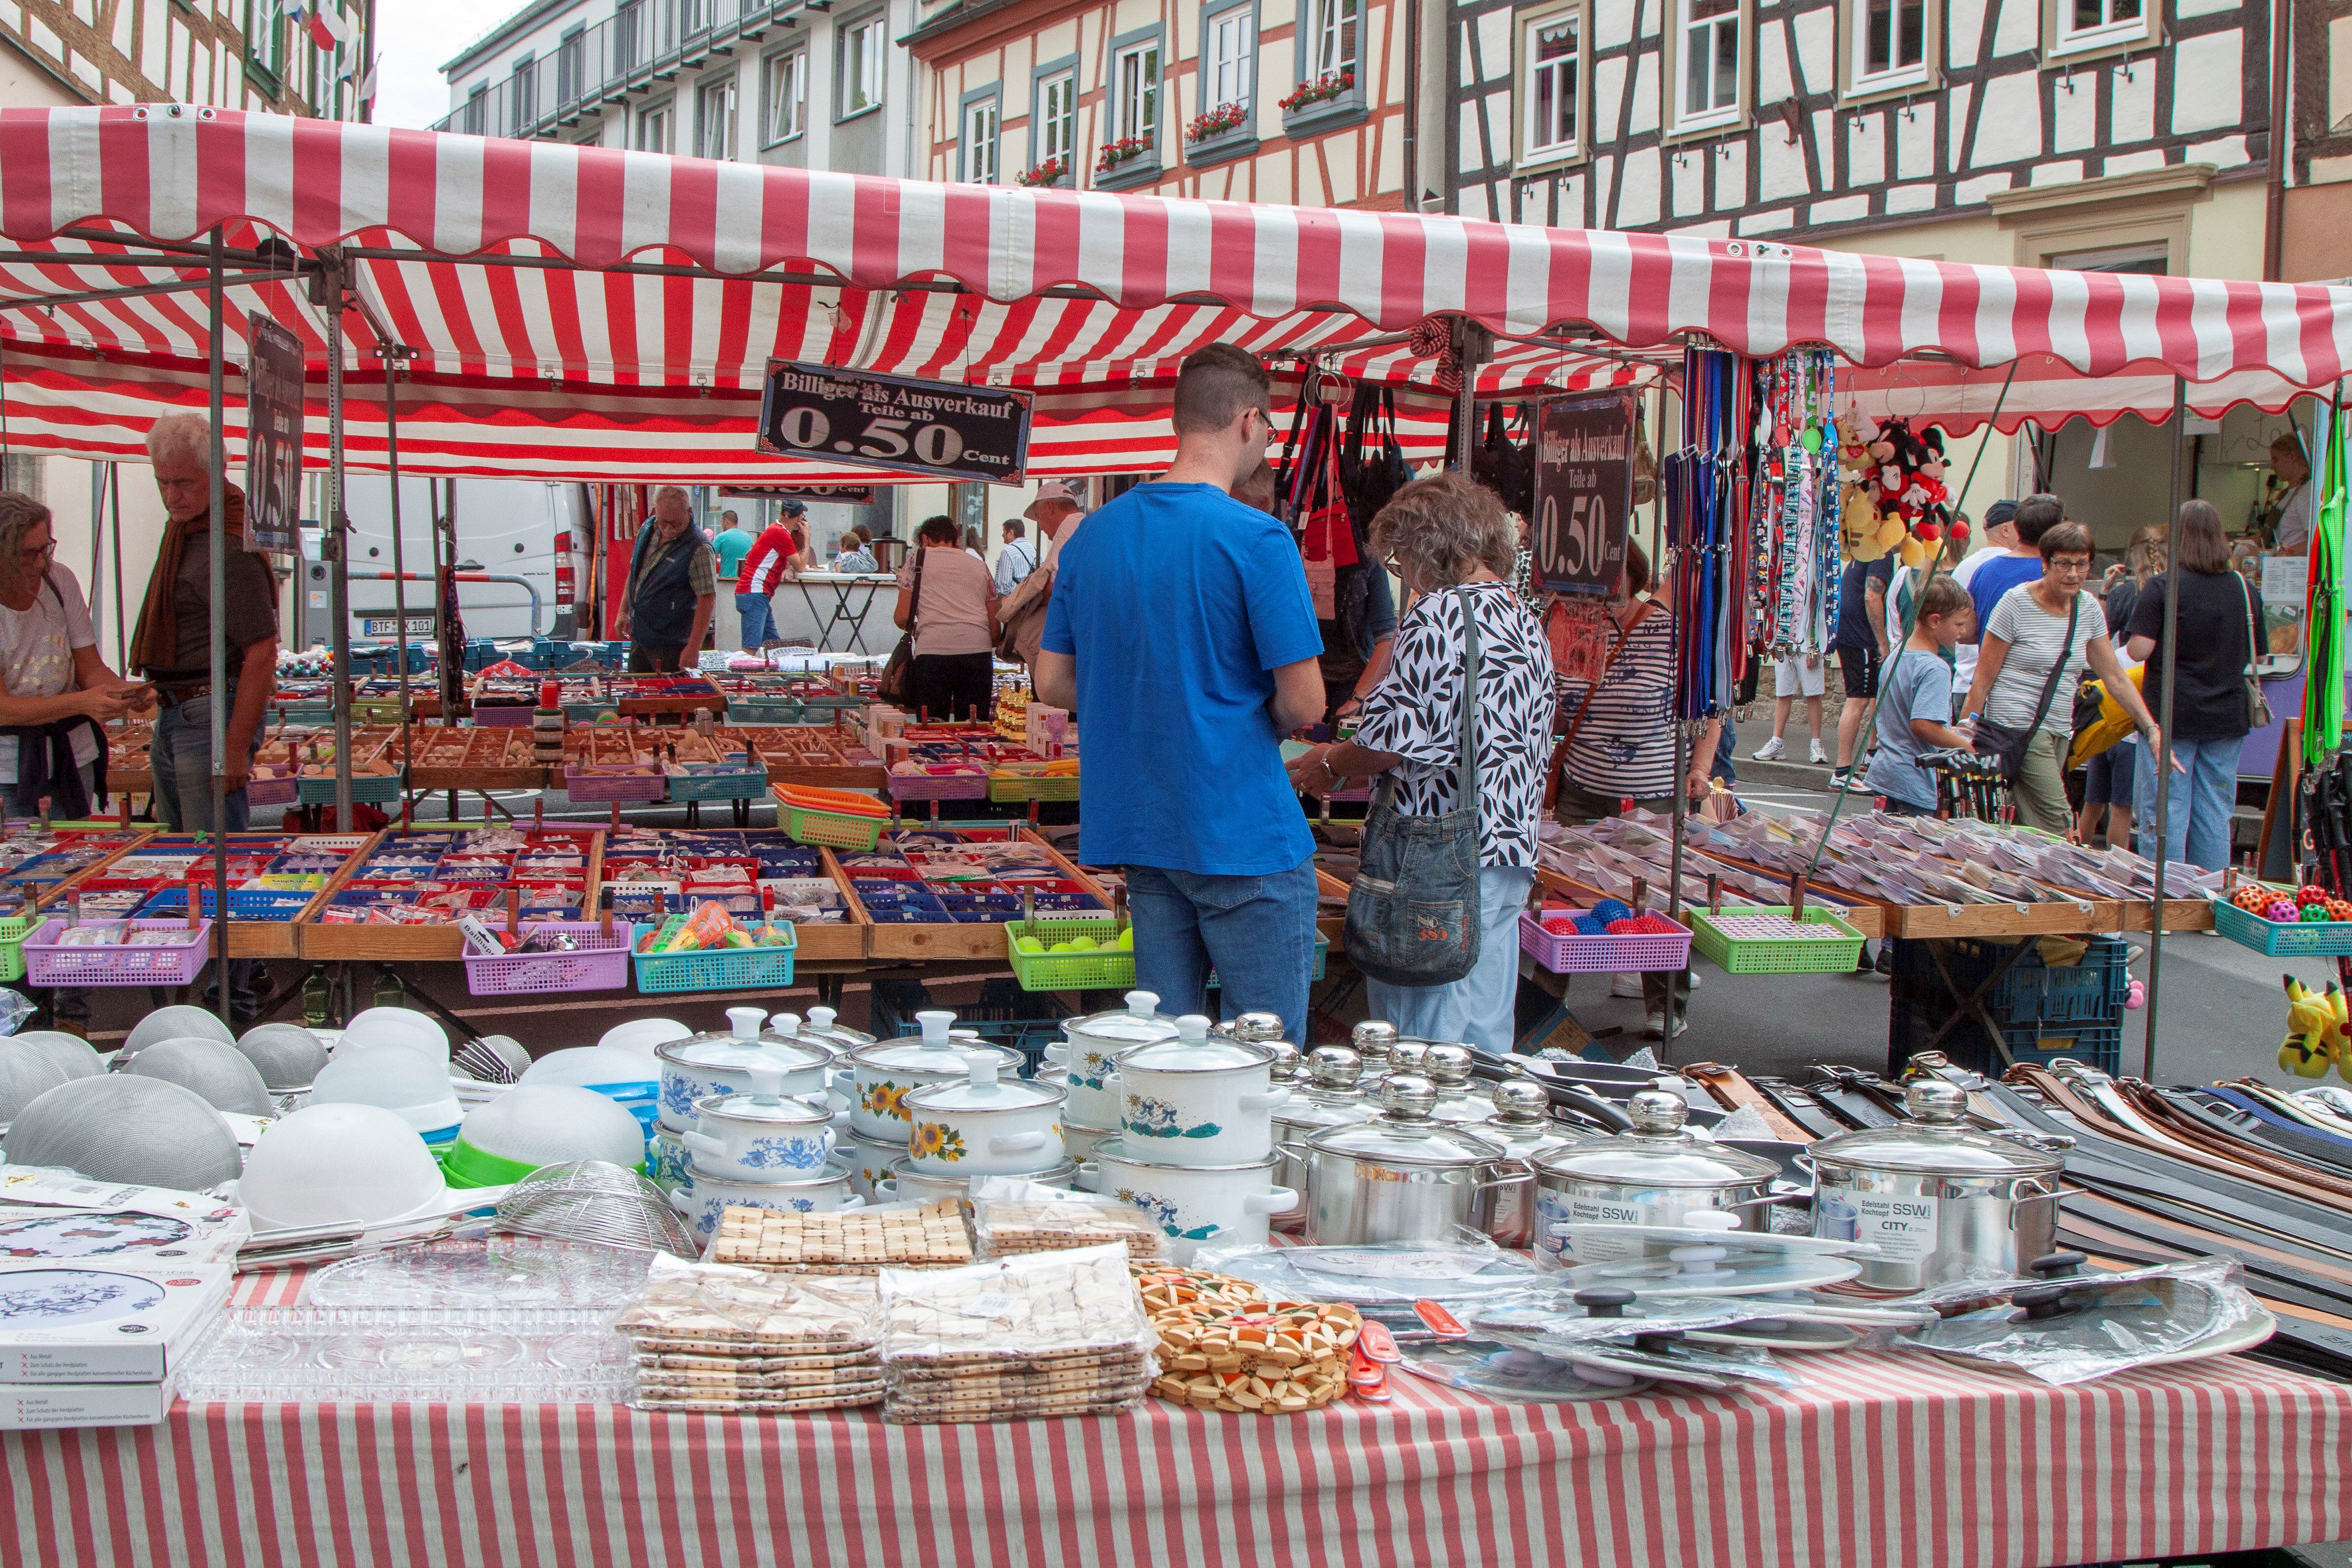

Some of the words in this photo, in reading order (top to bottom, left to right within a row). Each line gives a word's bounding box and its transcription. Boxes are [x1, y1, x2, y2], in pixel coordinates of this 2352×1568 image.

[781, 372, 856, 400] Billiger
[862, 384, 889, 402] als
[895, 389, 1014, 419] Ausverkauf
[858, 402, 904, 418] Teile
[911, 410, 935, 421] ab
[781, 406, 963, 465] 0.50
[1542, 431, 1569, 472] Billiger
[1570, 428, 1581, 462] als
[1581, 424, 1626, 463] Ausverkauf
[963, 450, 1010, 465] Cent
[253, 432, 292, 526] 0.50
[1569, 469, 1586, 489] Teile
[1587, 469, 1596, 488] ab
[1540, 494, 1606, 576] 0.50
[1606, 540, 1620, 560] Cent
[372, 621, 390, 632] BTF
[412, 621, 430, 631] 101
[1574, 1202, 1599, 1212] Edelstahl
[1862, 1201, 1889, 1209] Edelstahl
[1893, 1203, 1927, 1216] SSW
[1573, 1210, 1598, 1221] Kochtopf
[1602, 1207, 1634, 1221] SSW
[1862, 1208, 1889, 1218] Kochtopf
[1882, 1221, 1908, 1231] CITY
[2319, 1335, 2352, 1348] JEA
